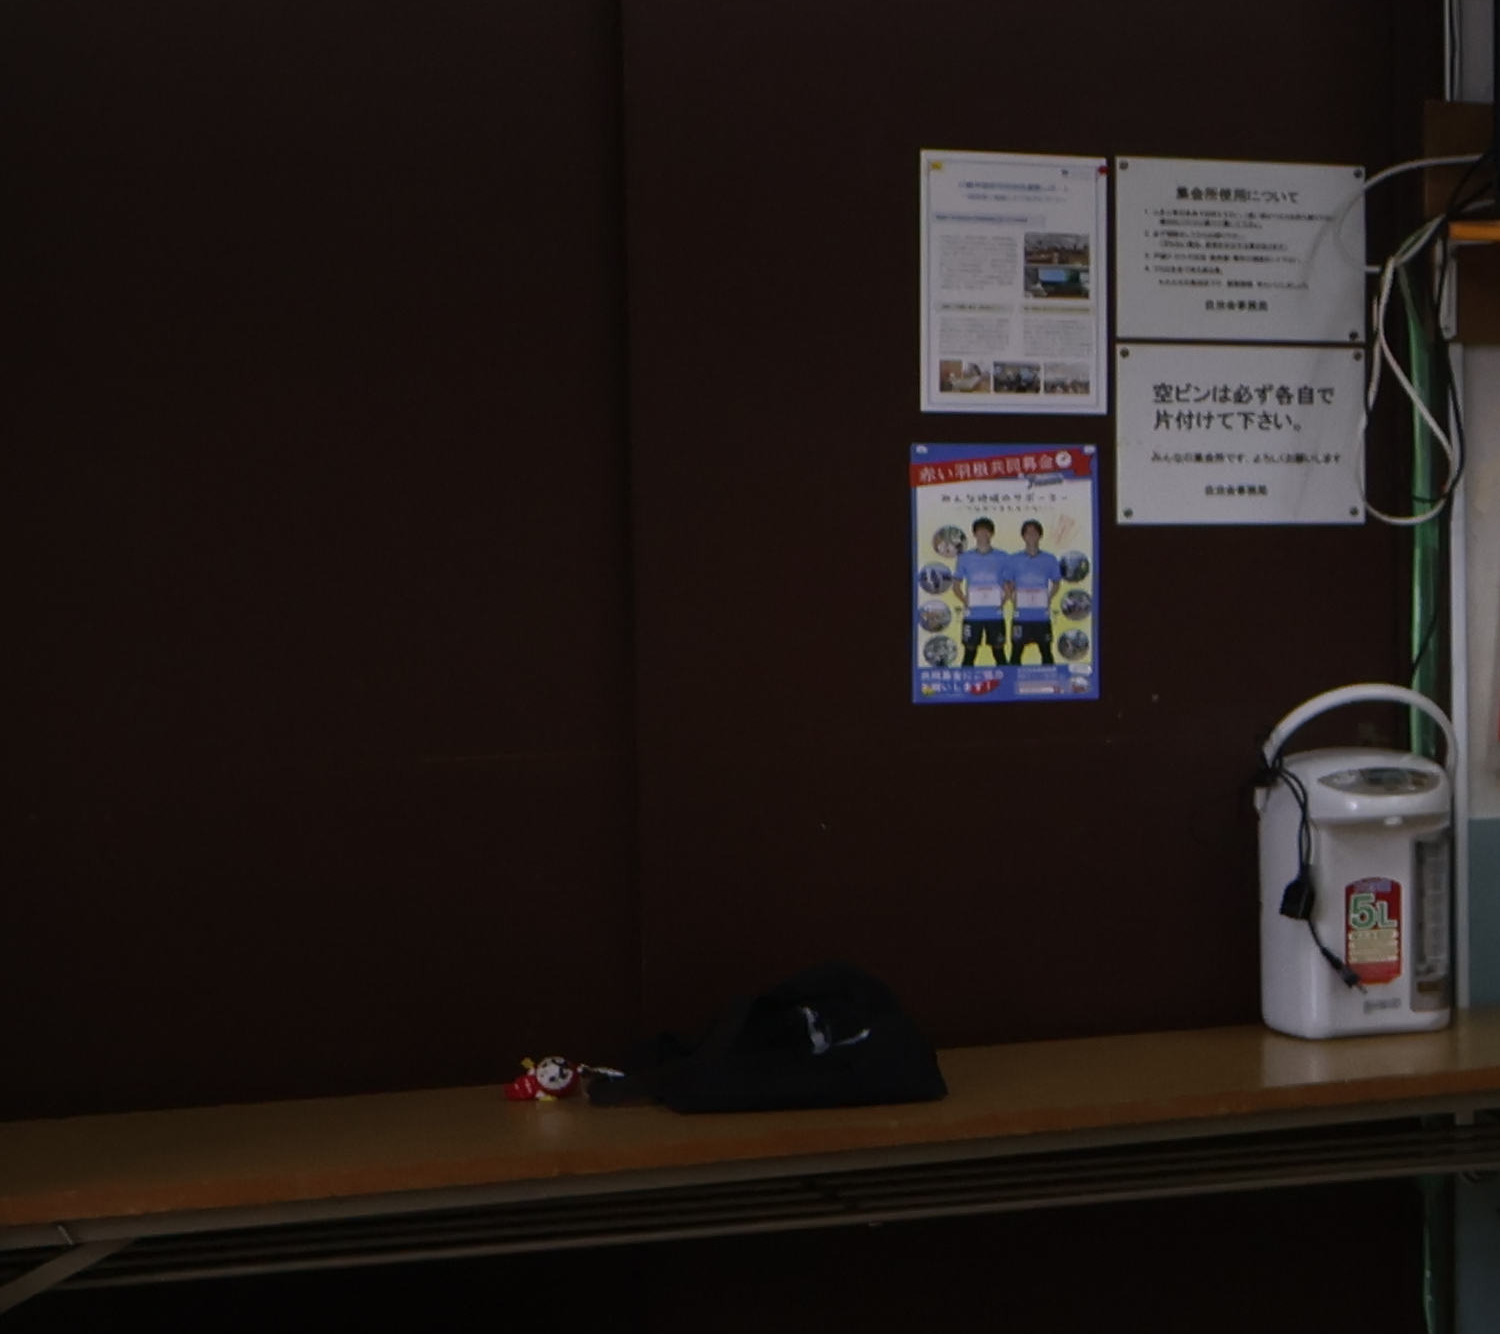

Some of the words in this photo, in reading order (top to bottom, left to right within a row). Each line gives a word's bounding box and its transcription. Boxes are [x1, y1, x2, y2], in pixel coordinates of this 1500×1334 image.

[1176, 185, 1300, 205] 集会所使用について
[1152, 382, 1335, 407] 空ビンは必ず各自で
[1153, 409, 1303, 432] 片付けて下さい。
[1348, 892, 1399, 929] 5L
